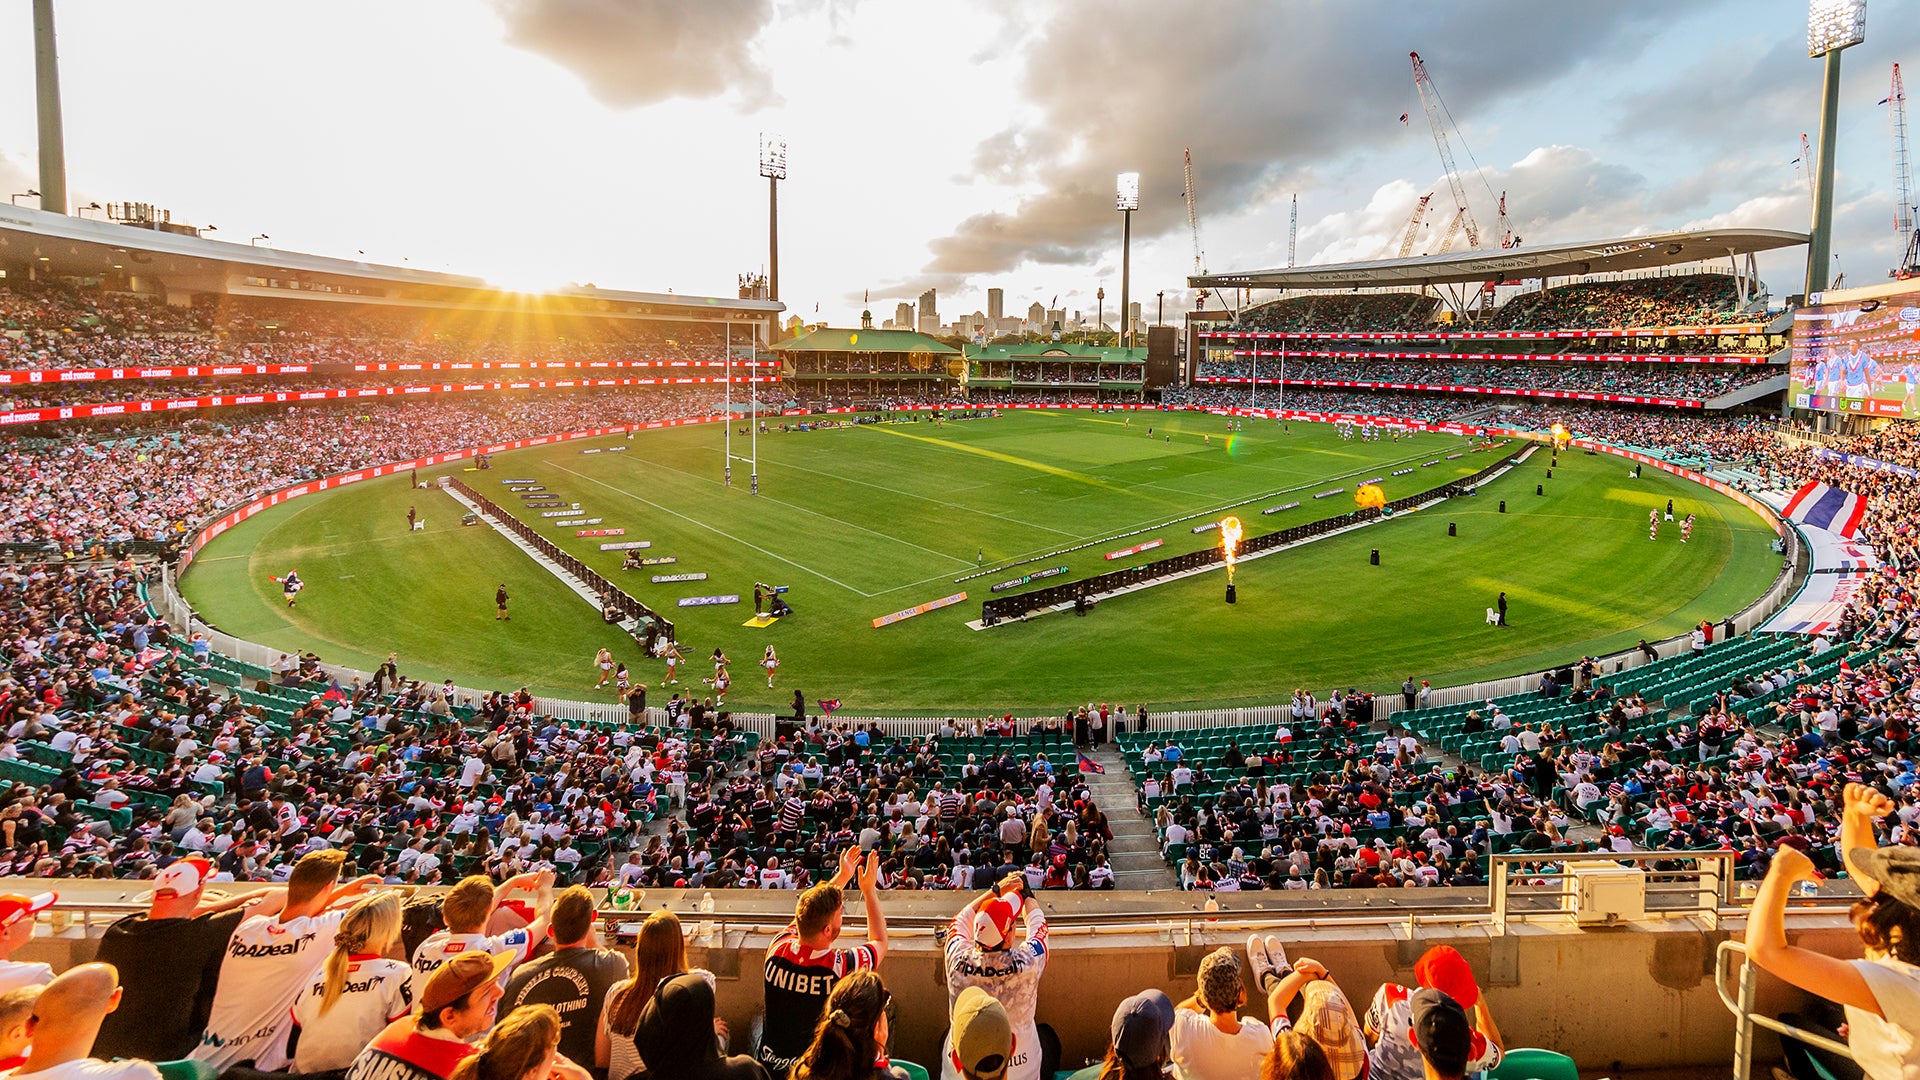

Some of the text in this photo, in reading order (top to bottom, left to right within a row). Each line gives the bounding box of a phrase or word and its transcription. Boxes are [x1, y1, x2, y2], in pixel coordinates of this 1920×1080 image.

[1, 412, 40, 424] red rooster
[897, 607, 917, 617] FENCE
[670, 709, 677, 717] 6
[765, 960, 834, 996] UNIBET
[552, 998, 588, 1014] LOTHING
